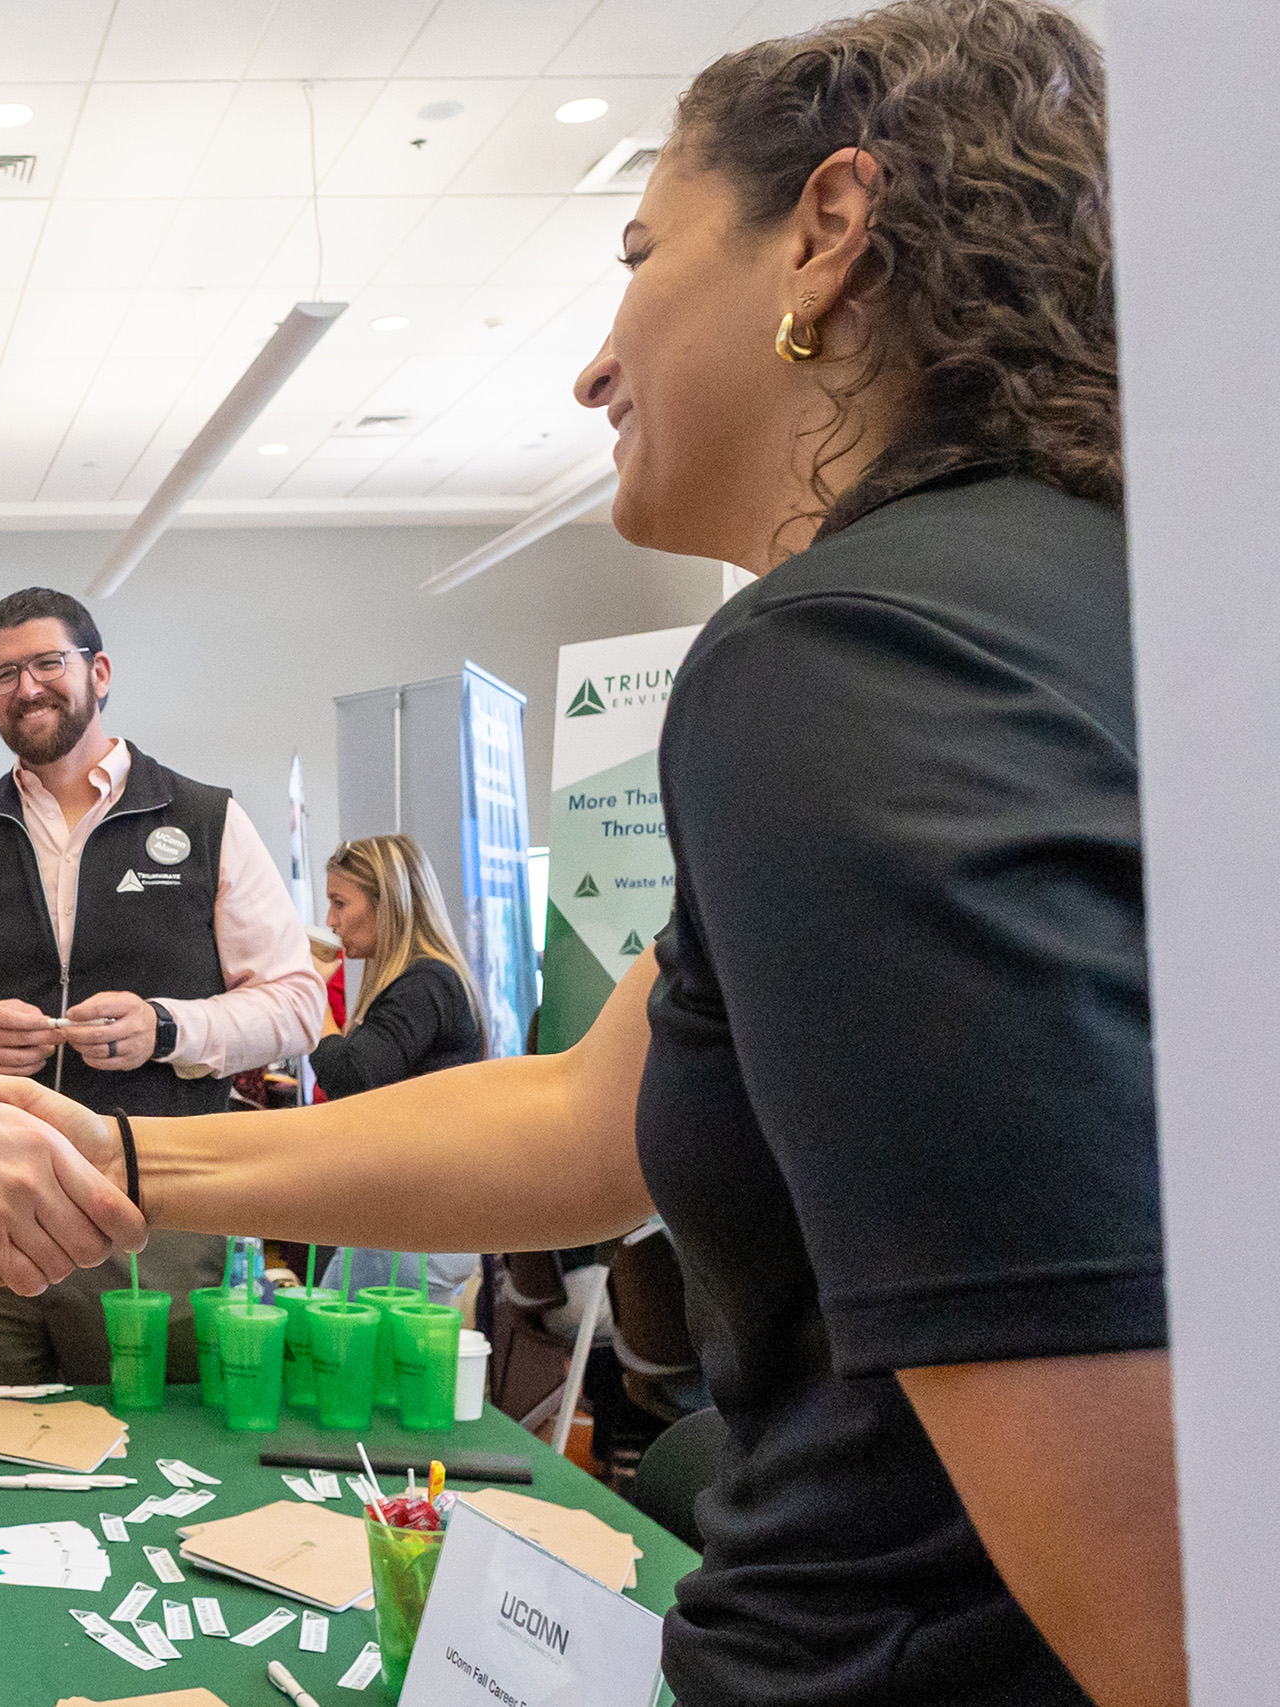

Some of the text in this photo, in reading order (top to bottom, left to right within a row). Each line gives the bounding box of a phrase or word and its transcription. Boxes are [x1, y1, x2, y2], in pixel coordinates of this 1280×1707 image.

[568, 794, 617, 811] More
[154, 841, 179, 855] Alum
[155, 831, 187, 849] UConn
[614, 876, 656, 889] Waste
[500, 1590, 570, 1656] UCONN
[445, 1646, 473, 1675] UConn
[472, 1666, 489, 1688] Fall
[488, 1678, 519, 1707] Career
